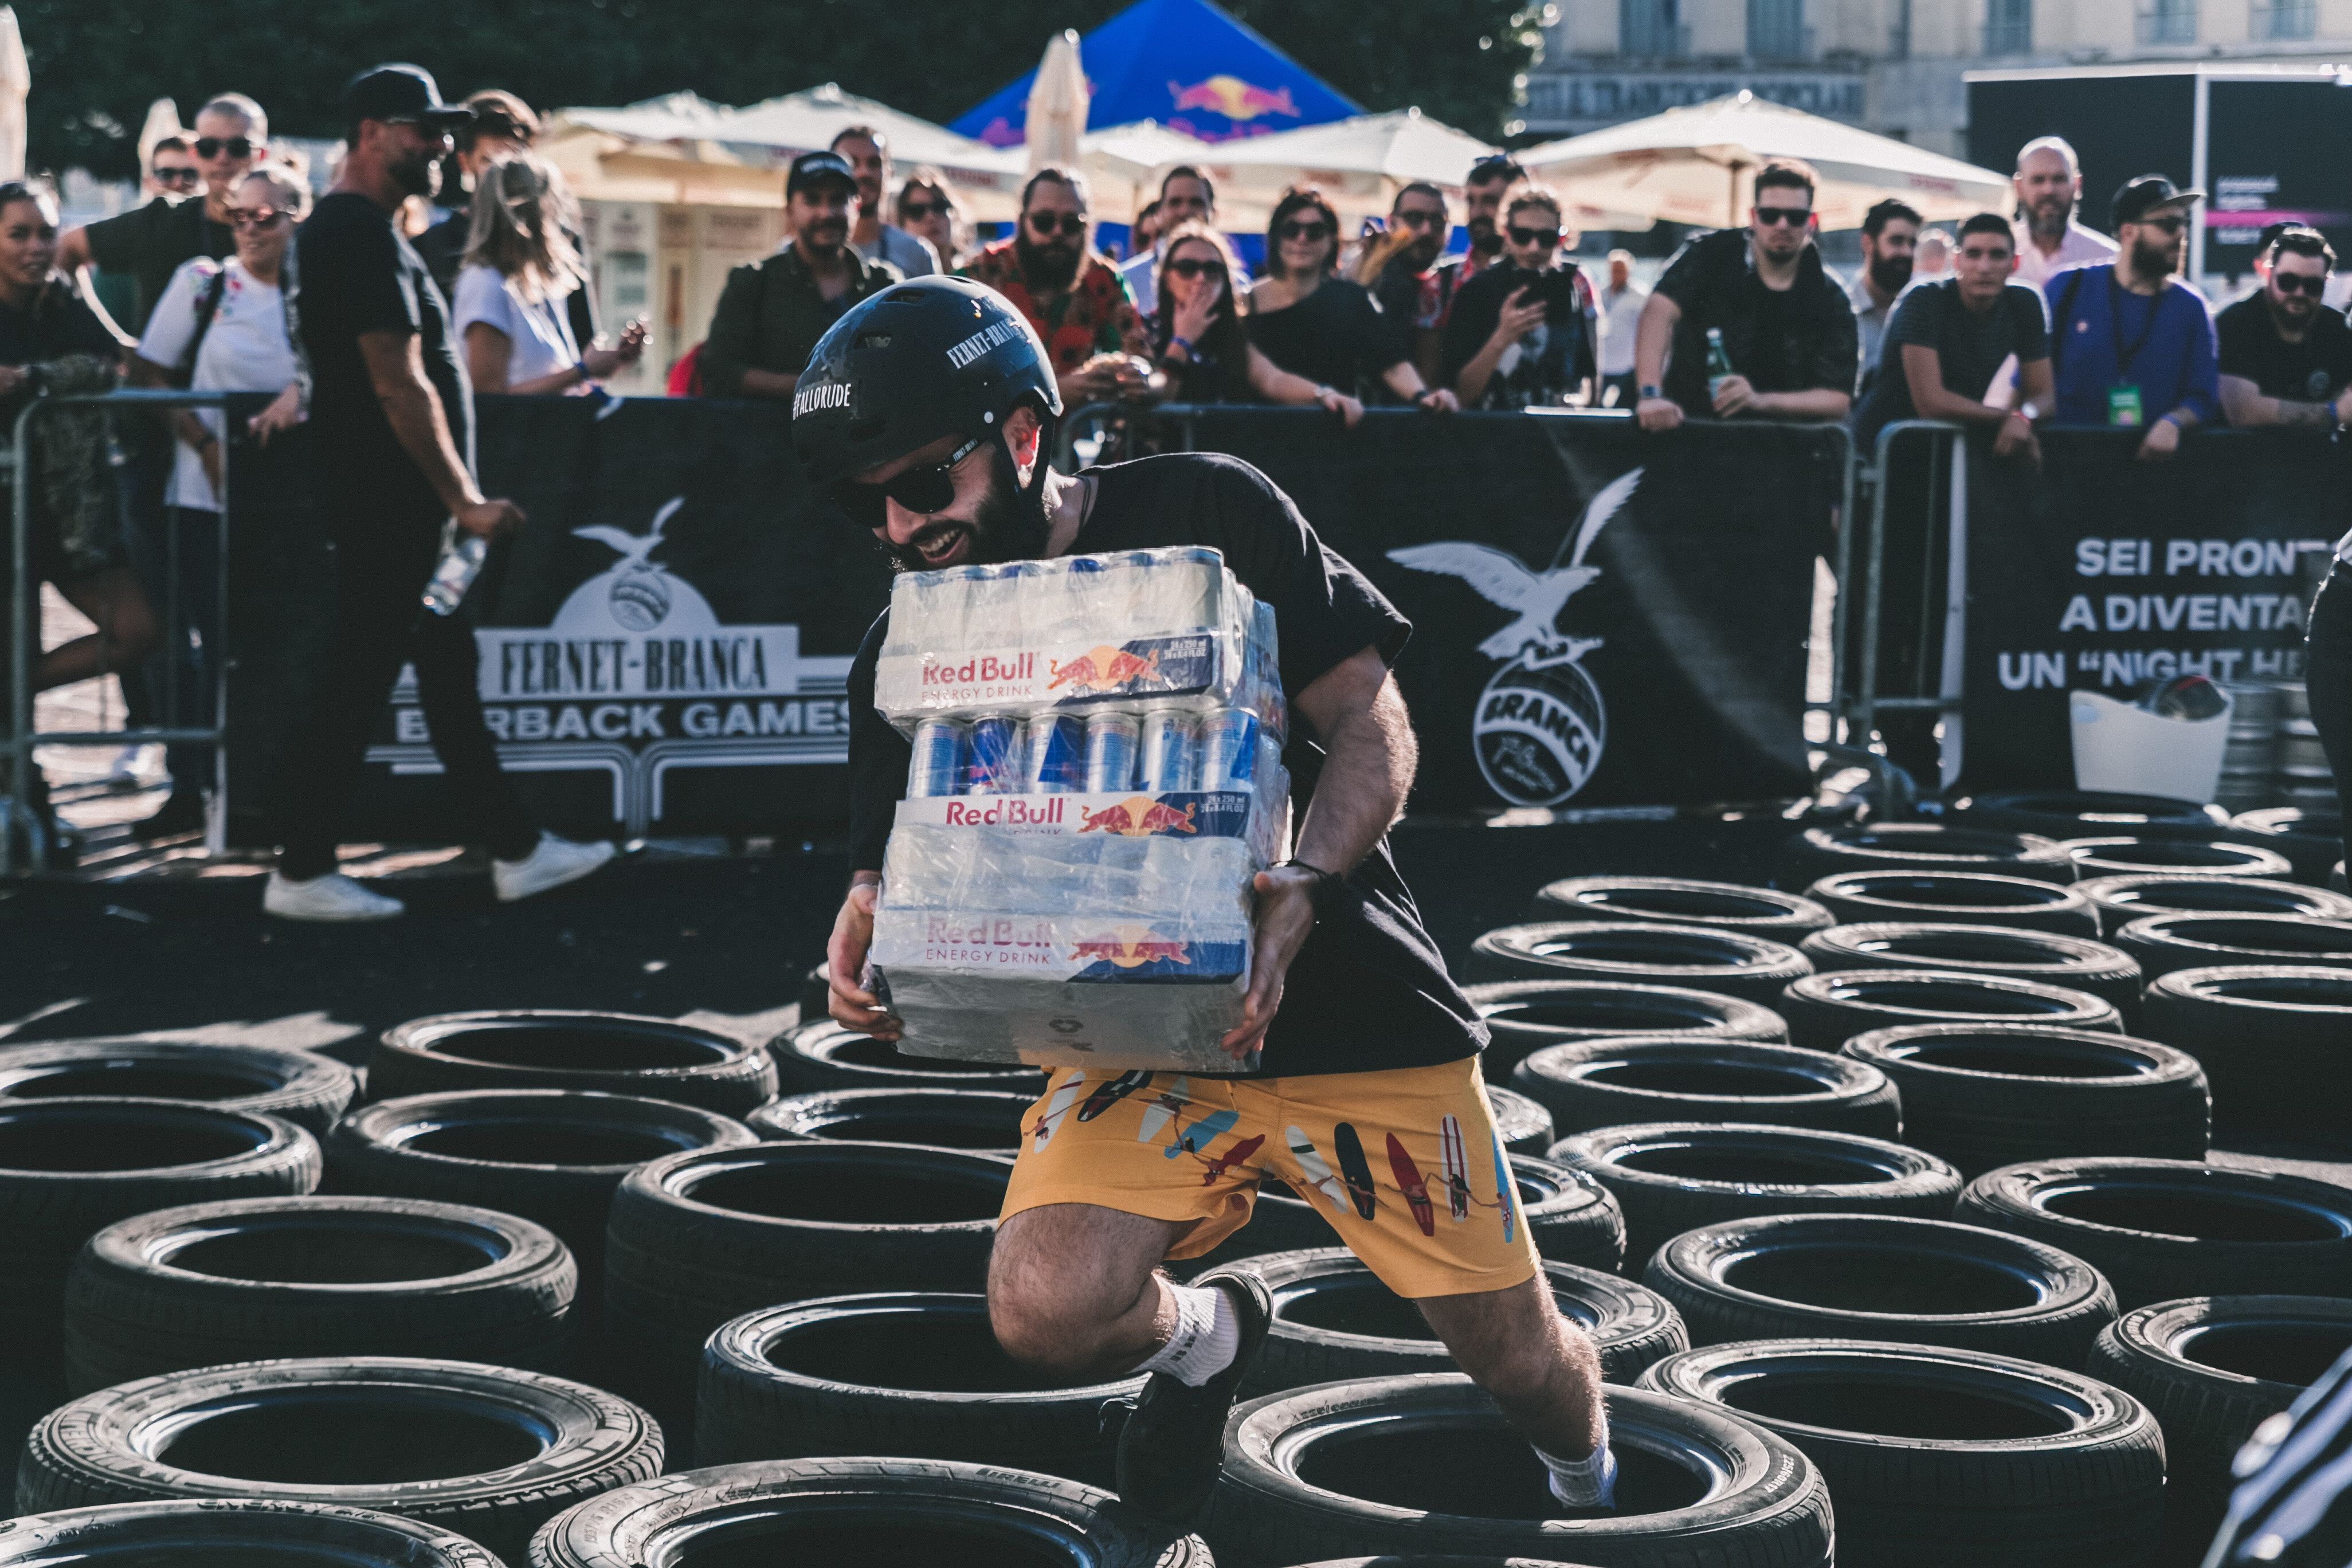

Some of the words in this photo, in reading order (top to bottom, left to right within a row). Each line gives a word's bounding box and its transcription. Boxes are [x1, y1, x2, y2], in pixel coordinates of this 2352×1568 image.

[2076, 538, 2151, 577] SEI
[2060, 594, 2098, 631] A
[500, 636, 769, 695] FERNET-BRANCA
[923, 656, 975, 685] Red
[981, 652, 1033, 681] Bull
[1998, 652, 2065, 690] UN
[922, 688, 980, 702] ENERGY
[987, 685, 1032, 698] DRINK
[397, 705, 665, 743] BRBACK
[946, 799, 1003, 826] Red
[1008, 798, 1064, 825] Bull
[927, 917, 988, 945] Red
[993, 920, 1053, 948] Bull
[926, 949, 993, 962] ENERGY
[999, 951, 1050, 965] DRINK
[1764, 1454, 1794, 1493] 225/60R17
